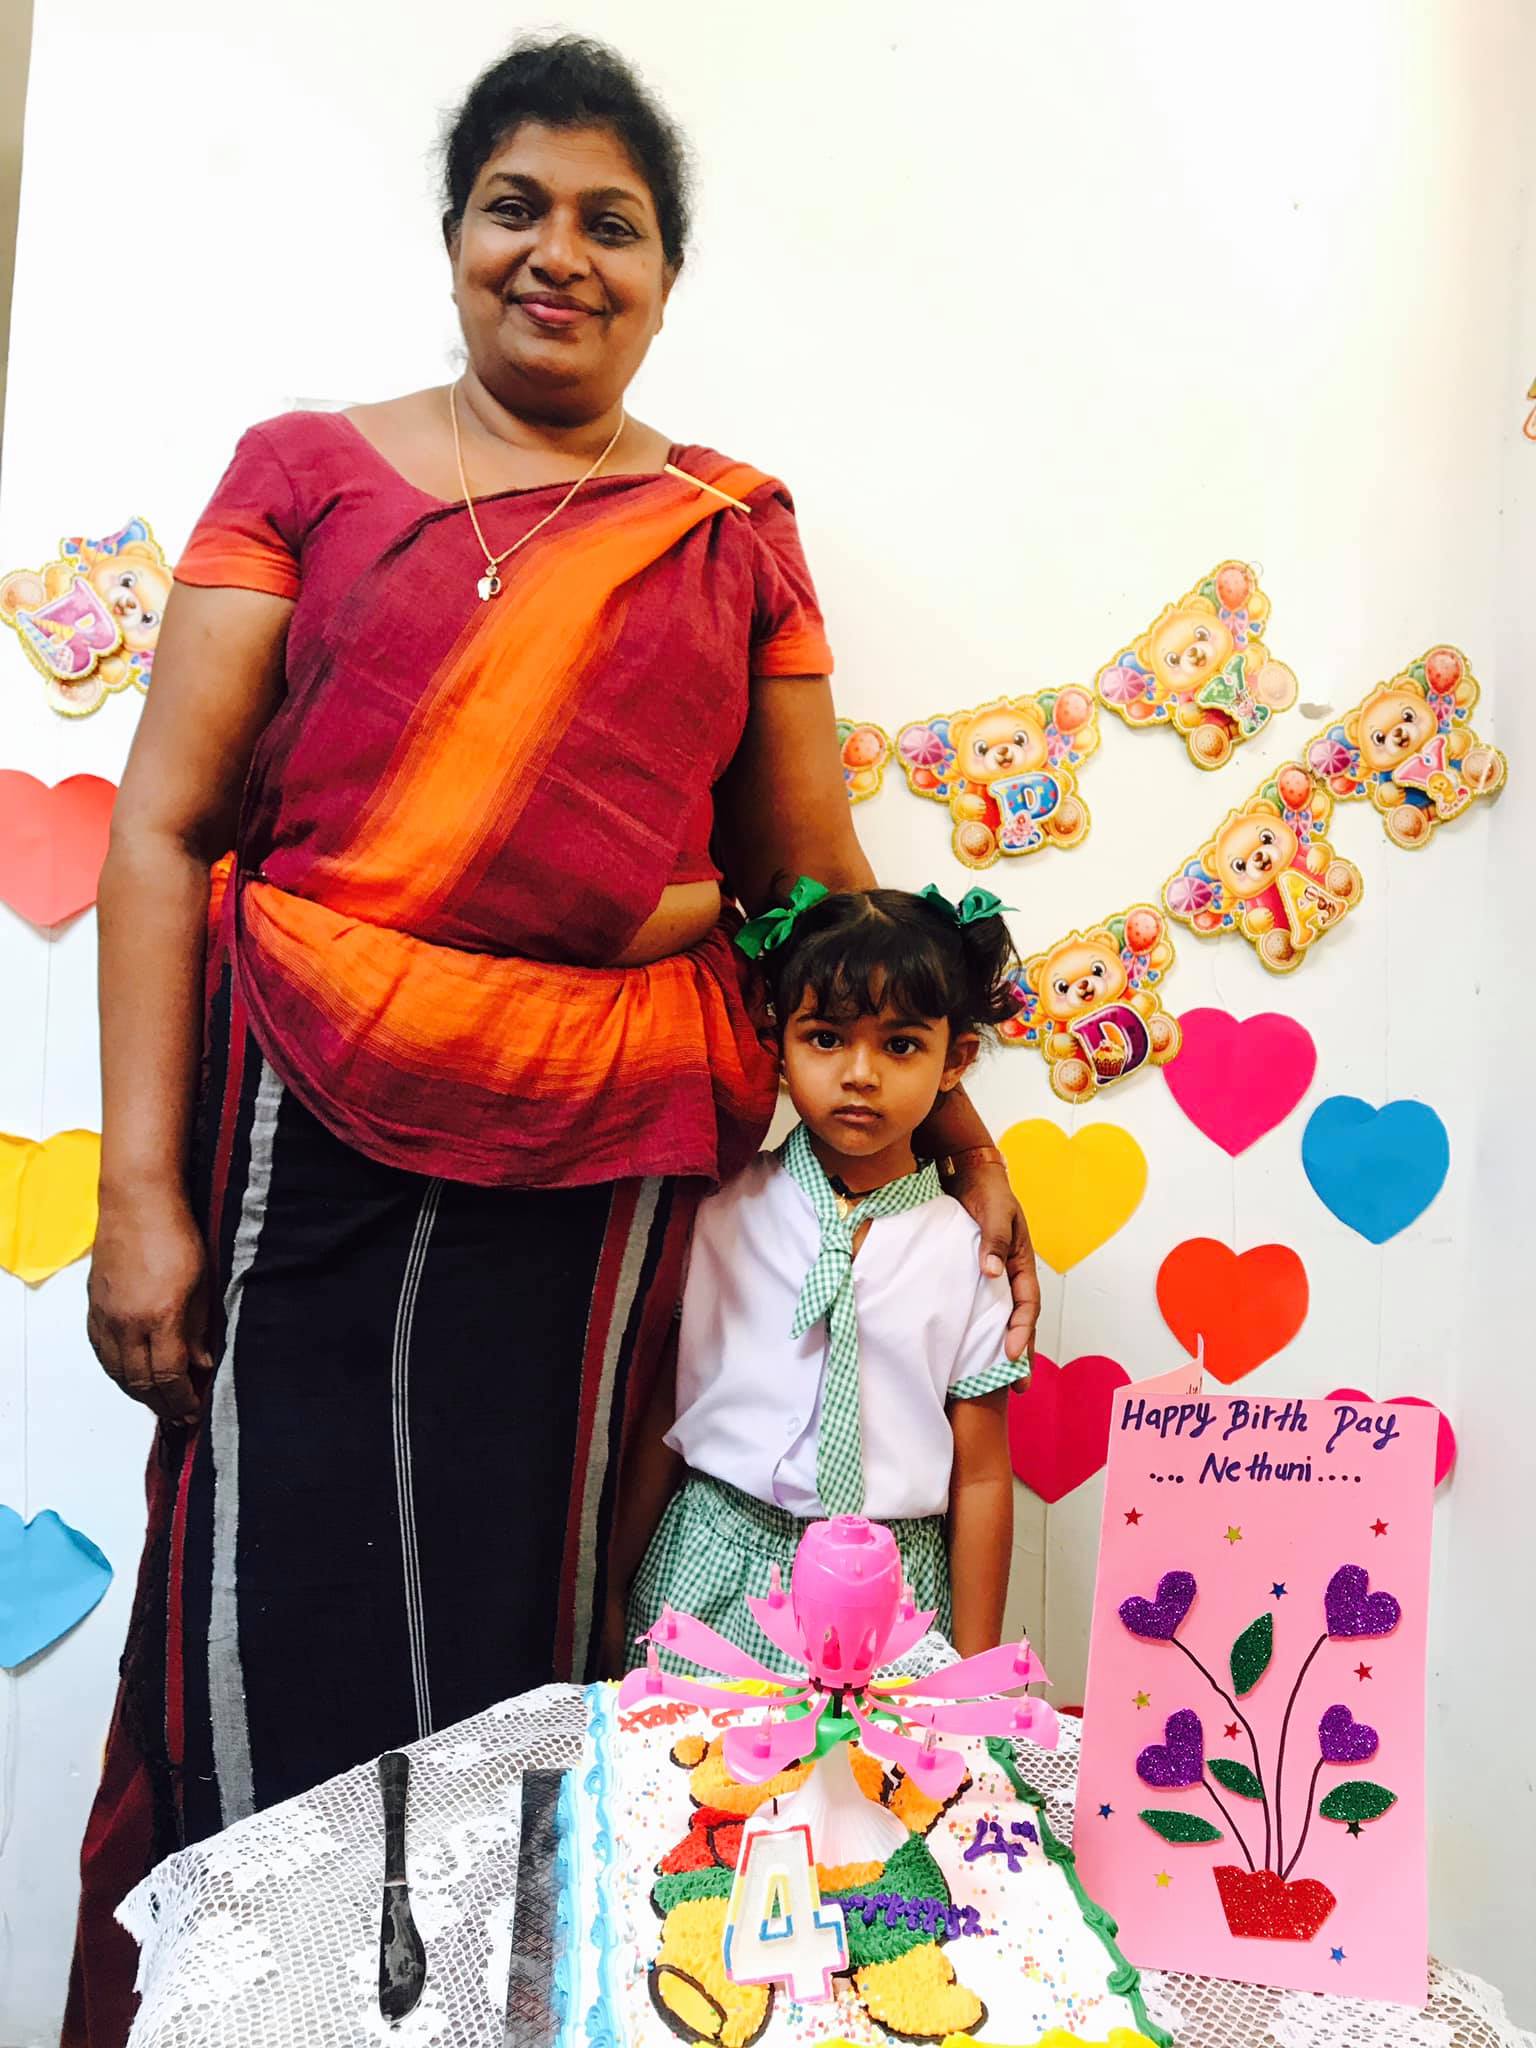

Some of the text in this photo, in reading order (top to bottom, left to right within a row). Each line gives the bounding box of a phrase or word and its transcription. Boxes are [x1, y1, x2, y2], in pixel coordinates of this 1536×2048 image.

[17, 574, 118, 675] B
[1121, 1399, 1400, 1453] Happy Birth Day
[722, 1817, 850, 2002] 4
